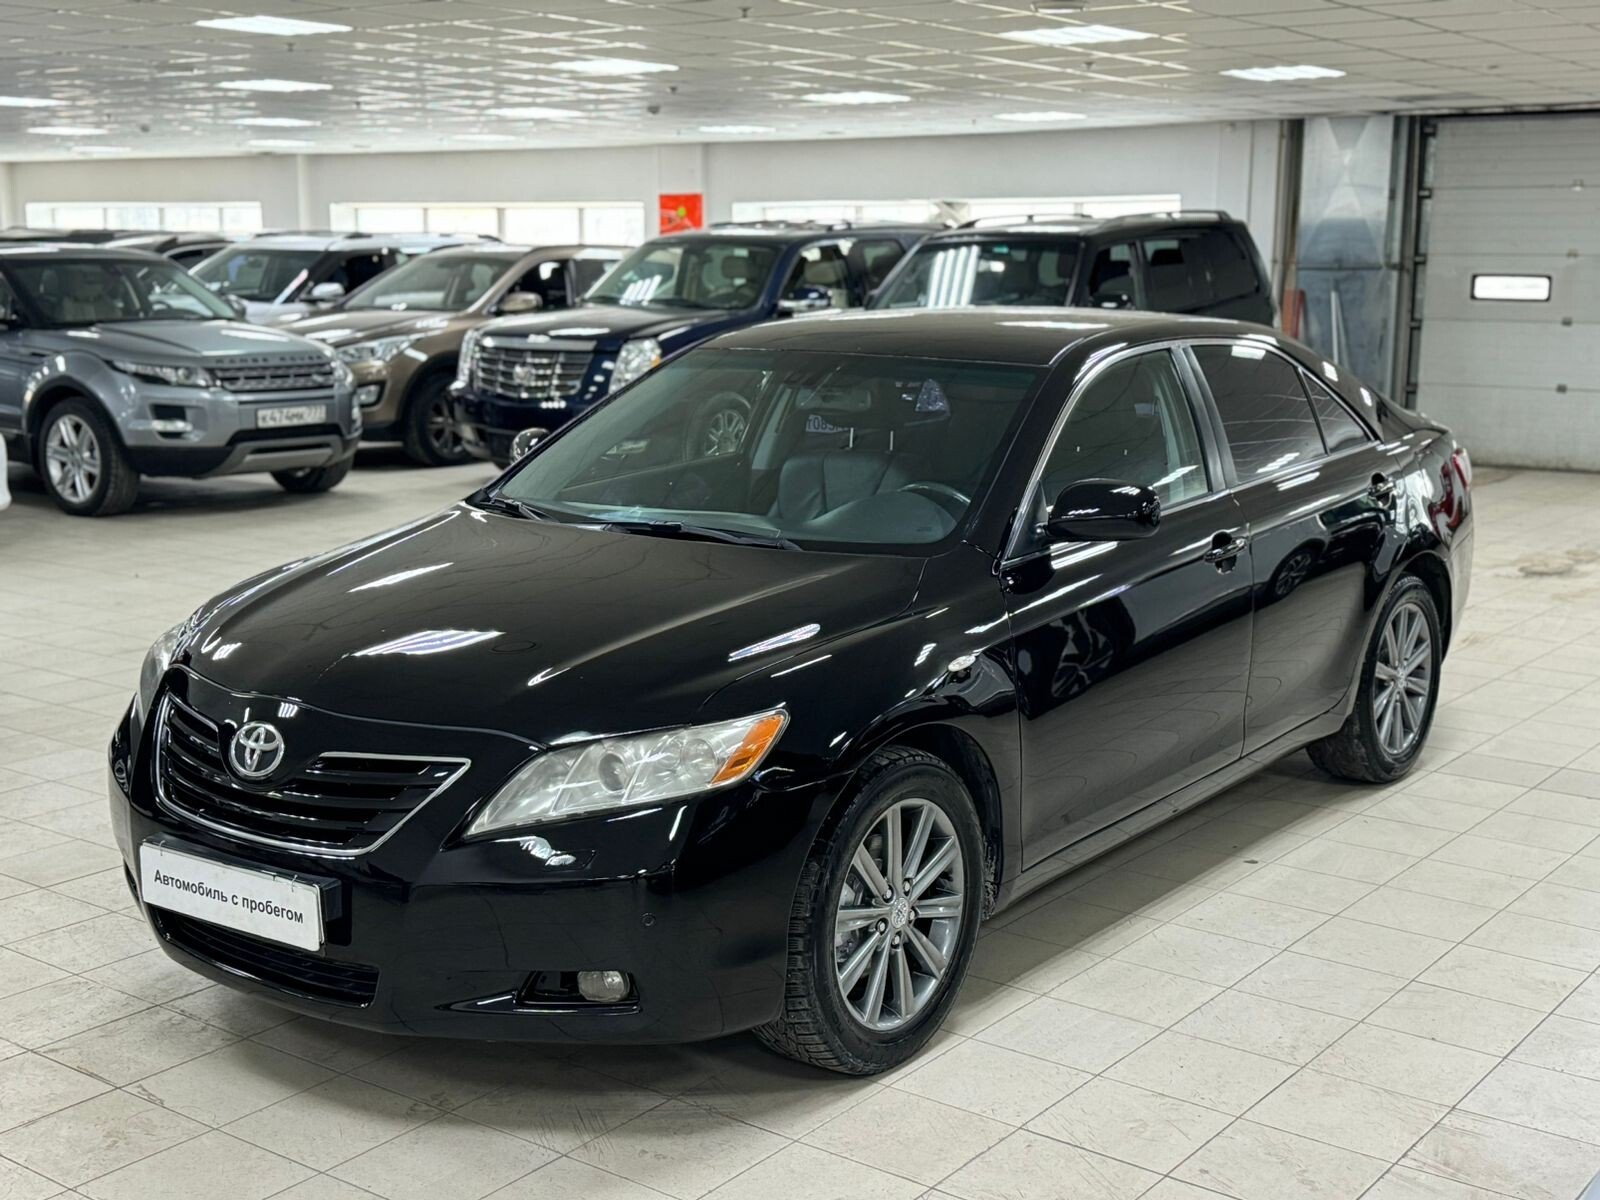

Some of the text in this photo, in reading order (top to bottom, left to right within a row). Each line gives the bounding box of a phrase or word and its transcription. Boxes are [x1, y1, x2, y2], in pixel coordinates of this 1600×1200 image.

[154, 869, 304, 924] Автомобиль с пробегом
